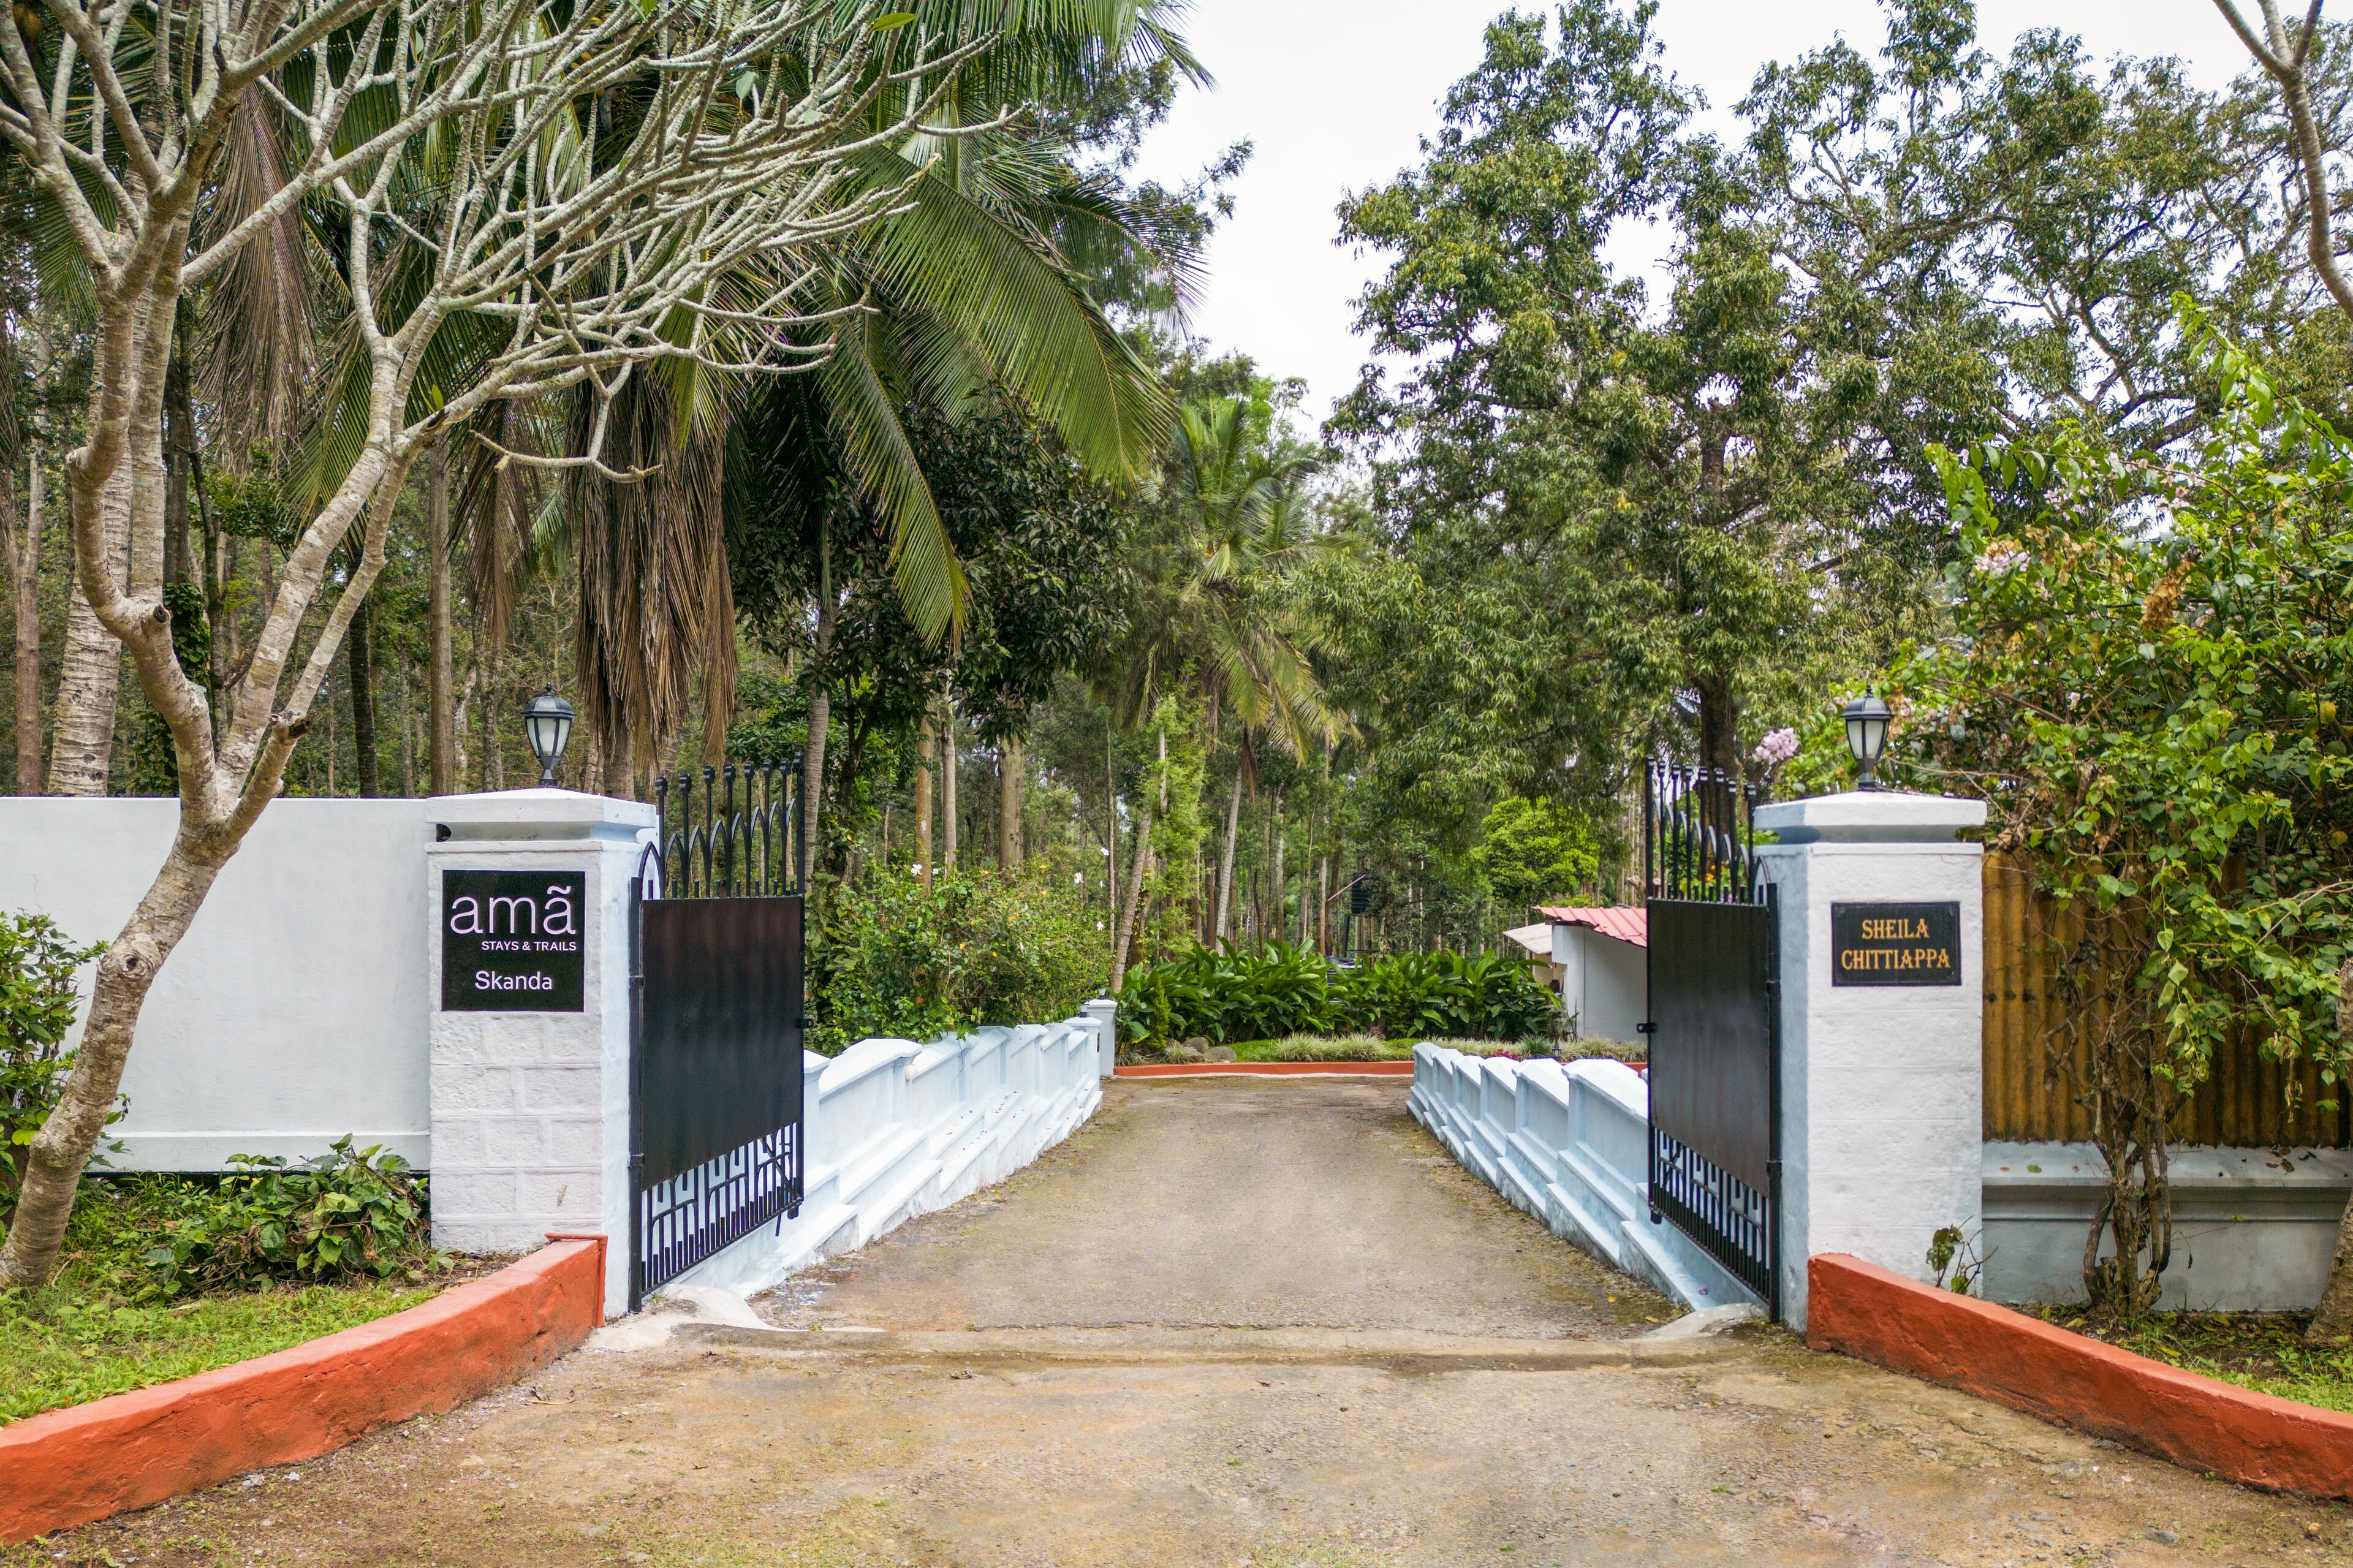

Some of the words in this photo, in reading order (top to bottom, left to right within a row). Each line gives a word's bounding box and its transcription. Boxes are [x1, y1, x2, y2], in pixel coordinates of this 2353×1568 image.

[1862, 918, 1930, 940] SHEILA
[481, 941, 519, 950] STAYS
[522, 941, 531, 950] &
[534, 941, 577, 951] TRAILS
[1841, 948, 1951, 970] CHITTIAPPA
[475, 971, 552, 990] Skanda
